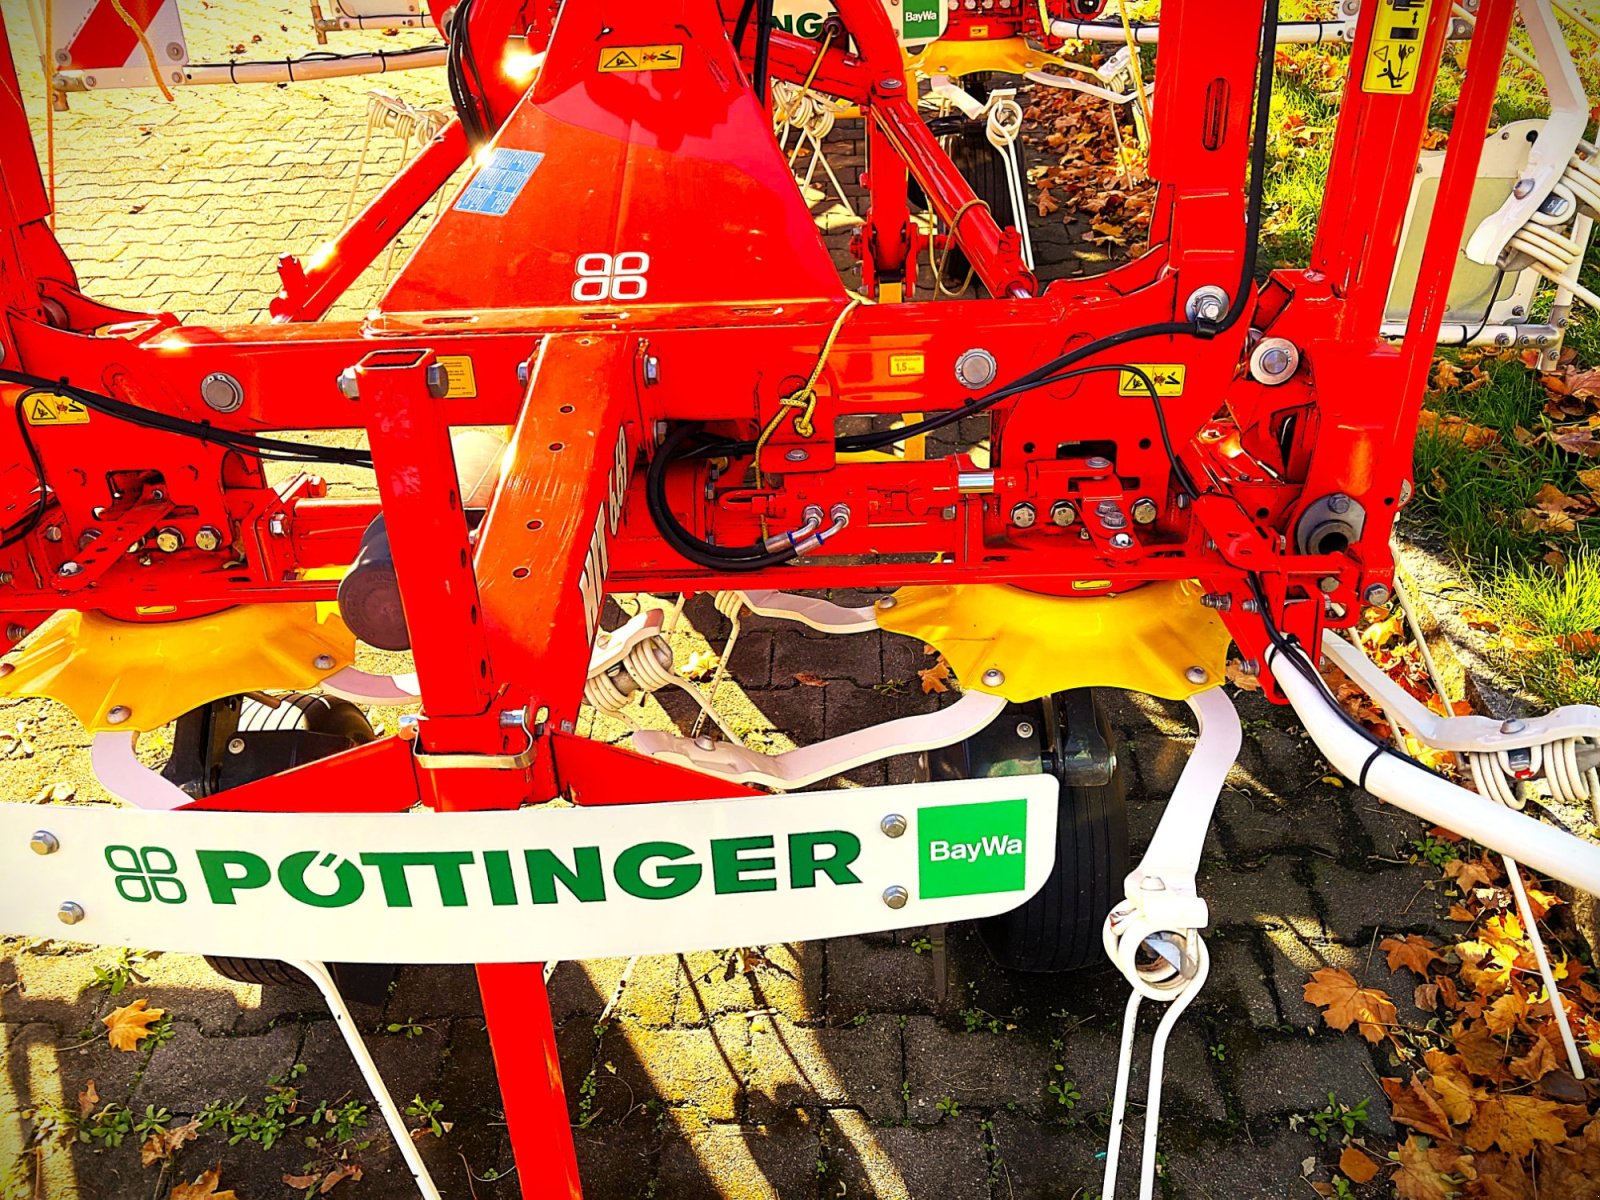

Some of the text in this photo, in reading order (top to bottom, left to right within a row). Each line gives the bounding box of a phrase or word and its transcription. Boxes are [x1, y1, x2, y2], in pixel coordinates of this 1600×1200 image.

[771, 12, 838, 38] NG
[905, 10, 937, 23] BayWa
[896, 362, 907, 372] 1,5
[578, 501, 609, 648] HIT
[930, 836, 1023, 862] BayWa
[197, 831, 861, 908] PÖTTINGER
